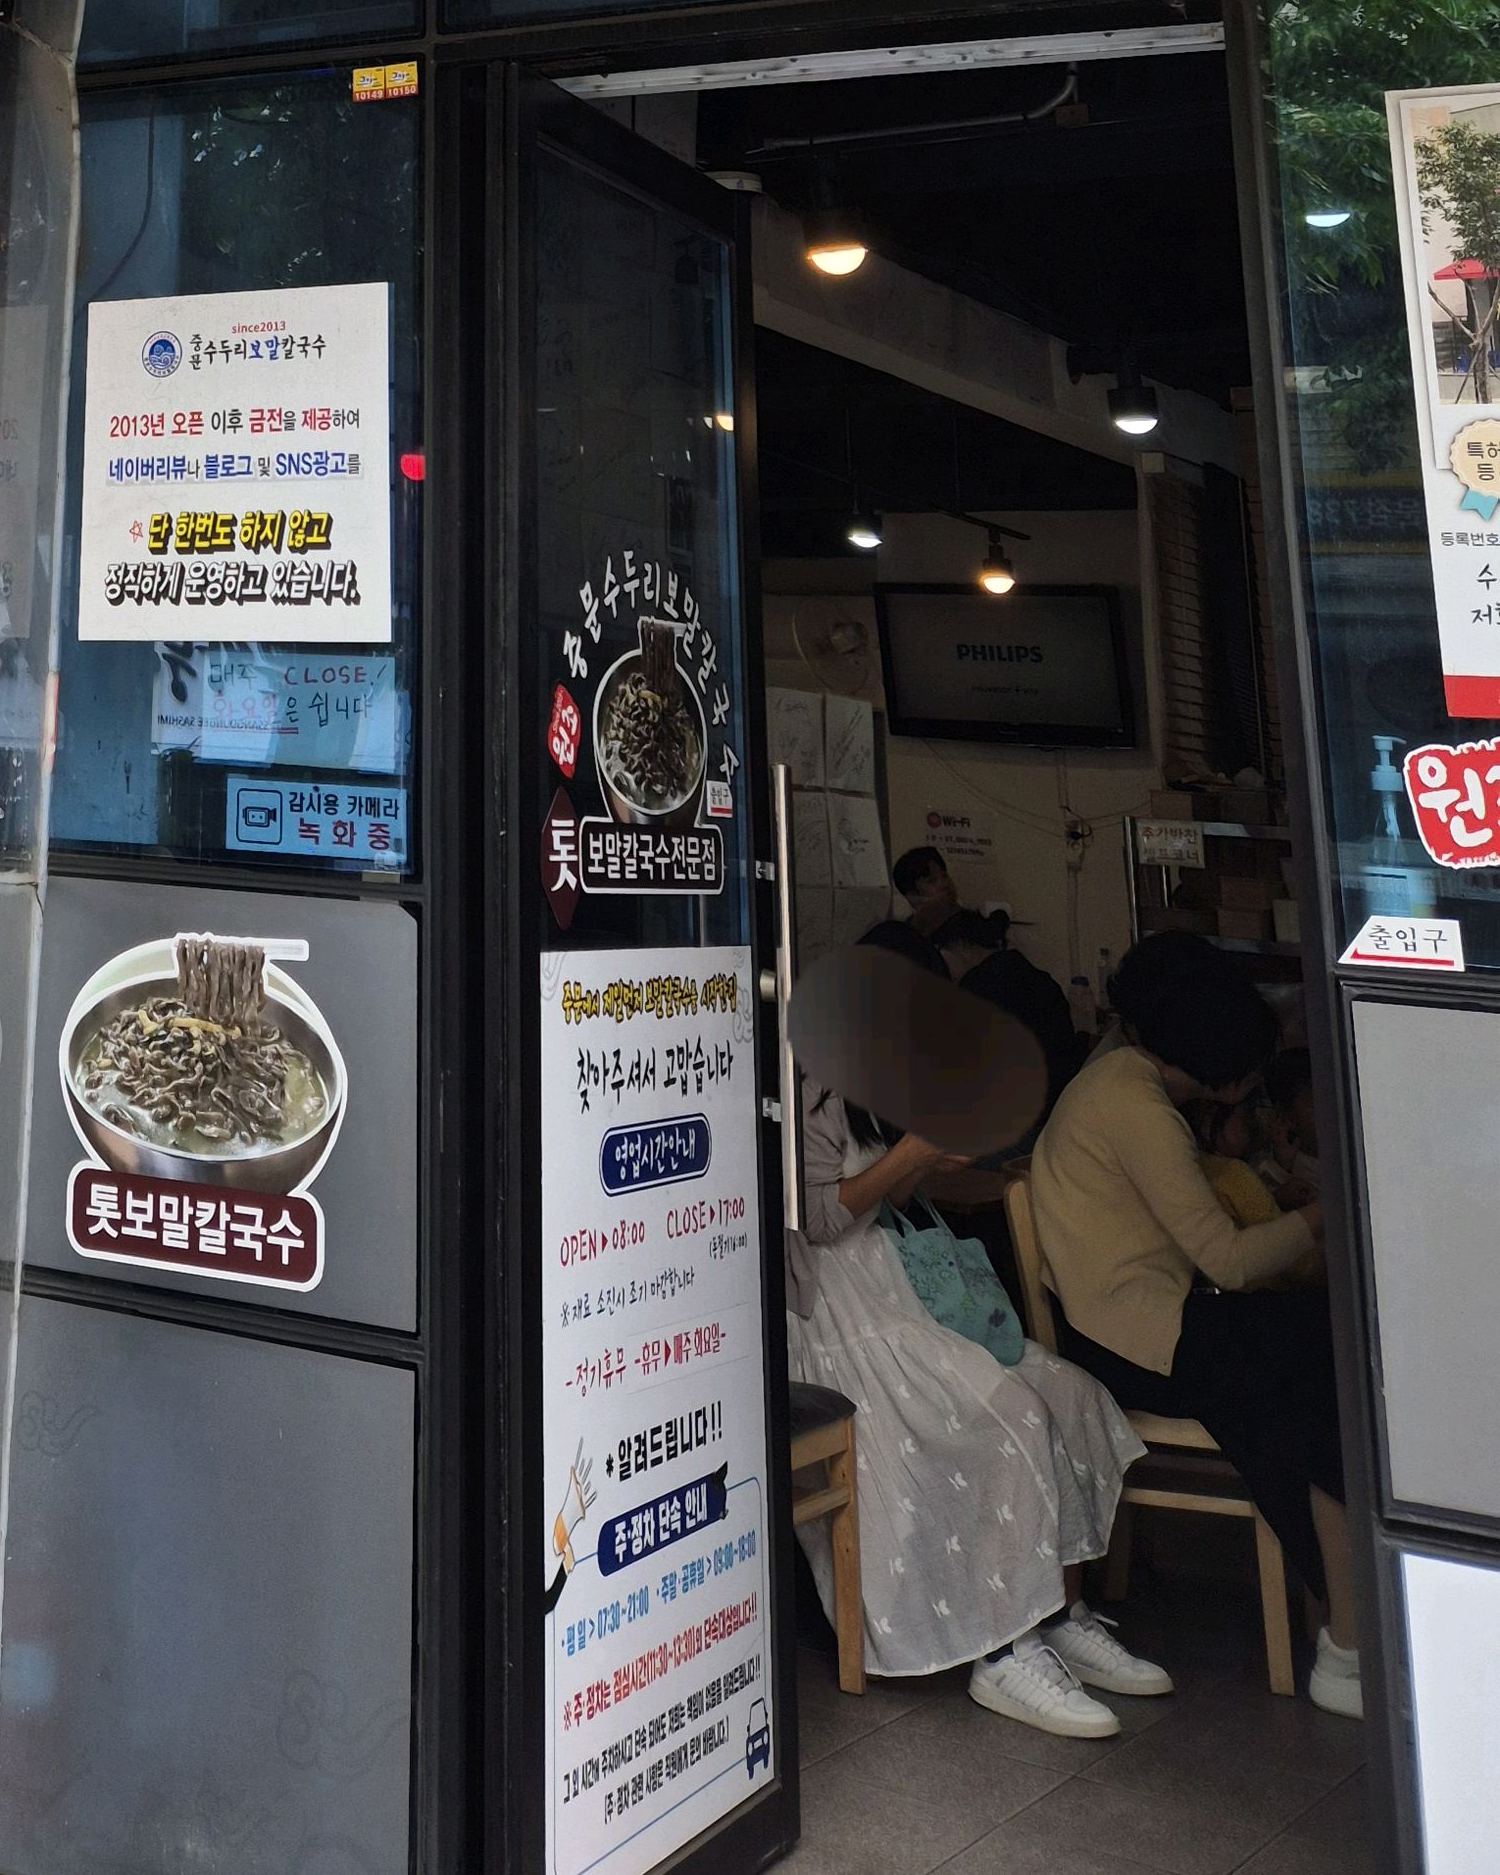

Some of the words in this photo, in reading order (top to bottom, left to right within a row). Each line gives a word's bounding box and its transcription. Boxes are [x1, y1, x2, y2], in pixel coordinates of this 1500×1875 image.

[203, 334, 327, 364] 수두리보말칼국수
[231, 321, 287, 335] since2013
[109, 411, 166, 438] 2013년
[171, 410, 205, 436] 오픈
[211, 408, 244, 434] 이후
[248, 407, 297, 433] 금전을
[301, 406, 361, 431] 제공하여
[108, 455, 200, 482] 네이버리뷰나
[203, 454, 252, 479] 블로그
[257, 455, 271, 477] 및
[274, 450, 362, 476] SNS광고를
[148, 513, 171, 553] 단
[173, 510, 237, 553] 한번도
[239, 509, 287, 552] 하지
[287, 508, 334, 551] 않고
[104, 561, 186, 606] 정직하게
[184, 560, 270, 606] 운영하고
[270, 558, 362, 606] 있습니다.
[1471, 602, 1500, 625] 저
[563, 550, 740, 785] 중문수두리보말칼국수
[955, 643, 1044, 664] PHILIPS
[288, 790, 339, 817] 감시용
[347, 794, 400, 820] 카메라
[548, 819, 578, 892] 톳
[587, 827, 717, 882] 보말칼국수전문점
[1368, 924, 1448, 953] 출입구
[577, 1046, 656, 1115] 찾아주셔서
[663, 1034, 734, 1098] 고맙습니다
[615, 1127, 697, 1182] 영업시간안내
[85, 1183, 305, 1266] 톳보말칼국수
[560, 1228, 597, 1267] OPEN
[612, 1219, 645, 1251] 08:00
[666, 1200, 707, 1239] CLOSE
[718, 1197, 745, 1228] 17:00
[572, 1293, 592, 1322] 재료
[629, 1280, 647, 1305] 조기
[650, 1265, 695, 1300] 마감합니다
[659, 1494, 681, 1542] 단속
[684, 1482, 708, 1531] 안내
